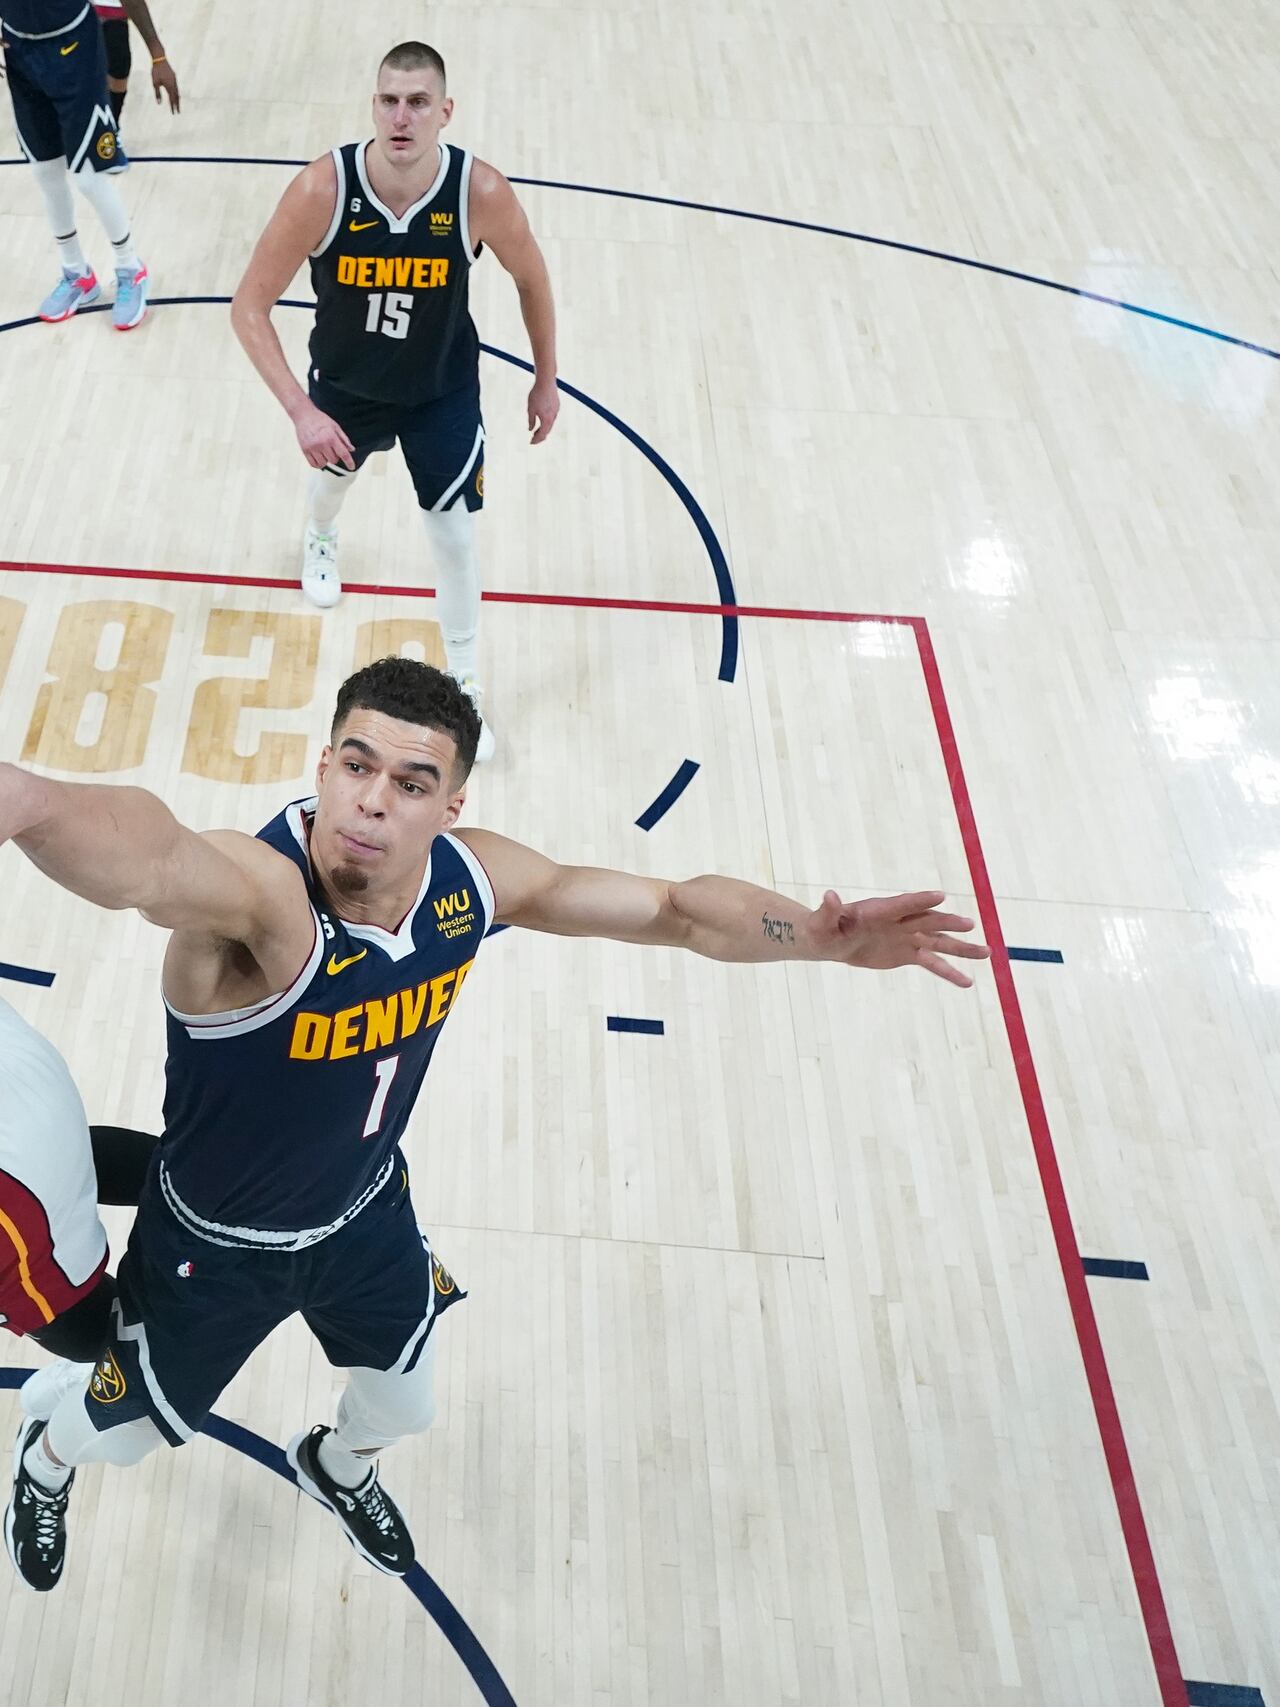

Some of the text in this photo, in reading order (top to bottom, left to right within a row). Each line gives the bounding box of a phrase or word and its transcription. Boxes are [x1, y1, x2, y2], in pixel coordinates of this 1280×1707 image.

[350, 197, 361, 213] 6
[431, 212, 453, 225] WU
[337, 255, 449, 288] DENVER
[365, 292, 414, 339] 15
[433, 889, 470, 919] WU
[437, 912, 475, 932] Western
[445, 923, 472, 939] Union
[362, 1055, 400, 1138] 1
